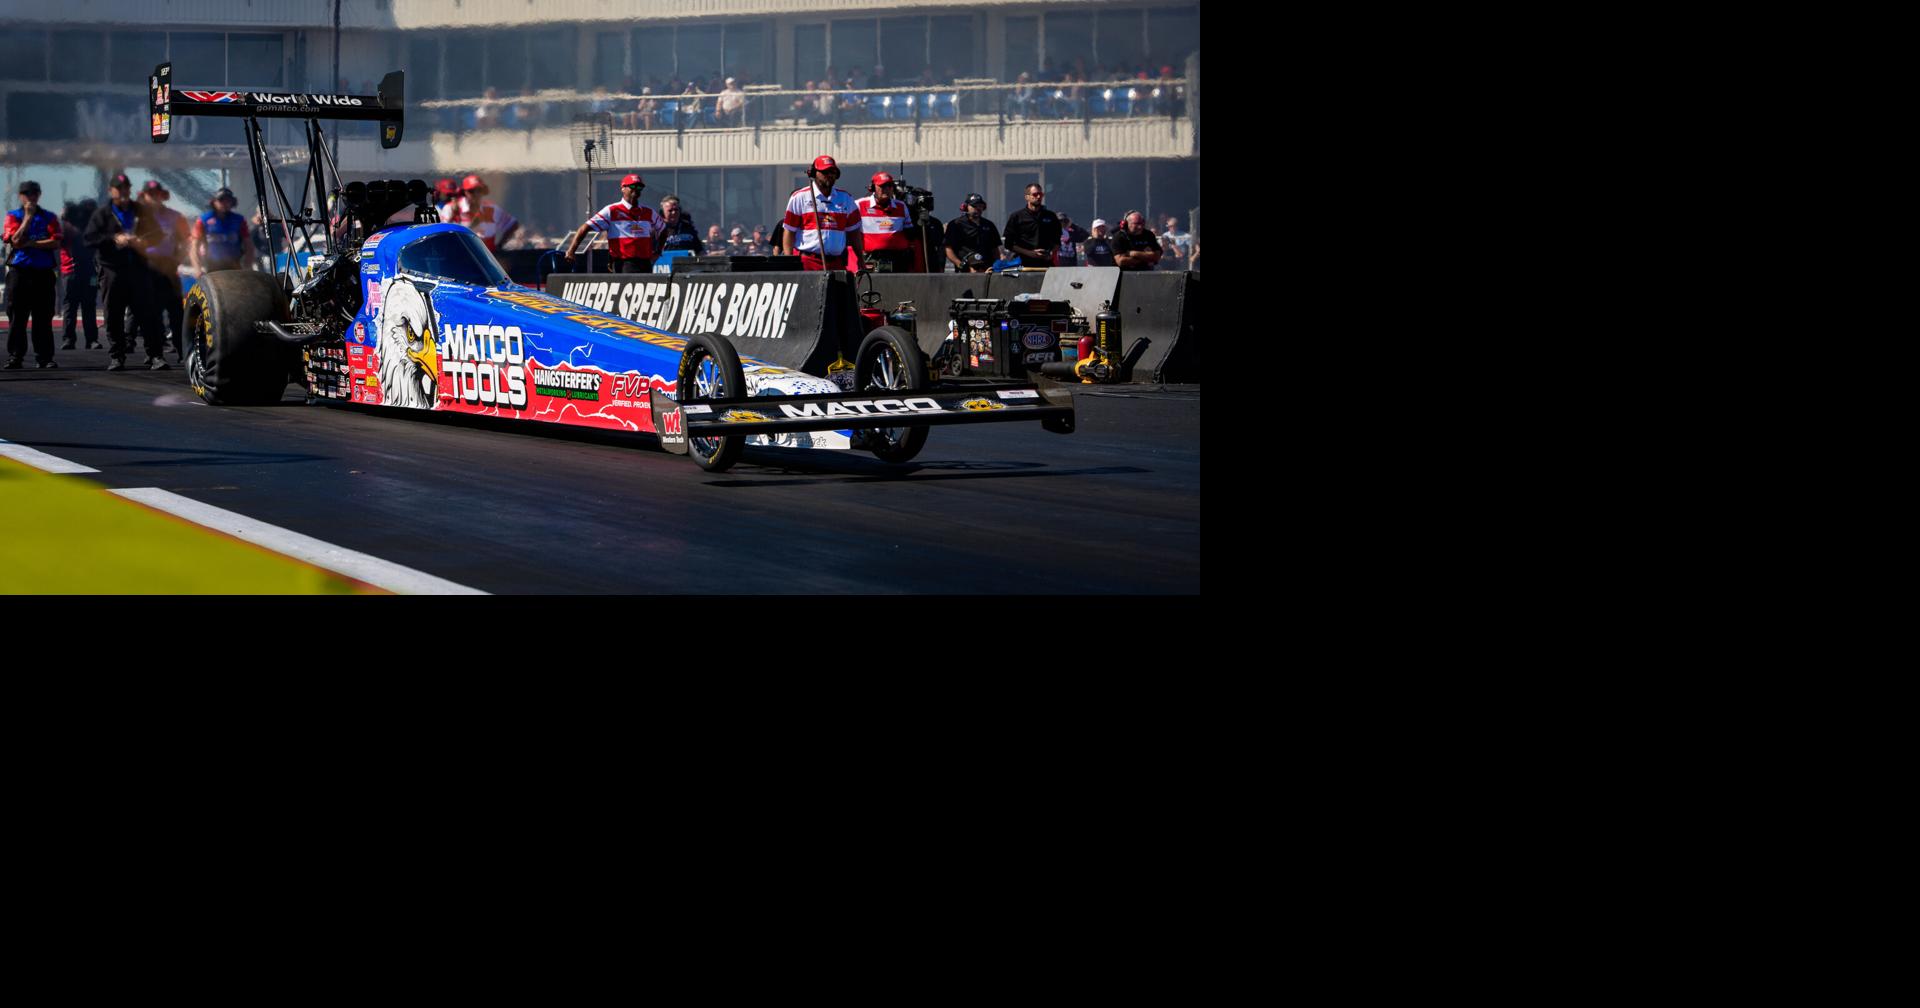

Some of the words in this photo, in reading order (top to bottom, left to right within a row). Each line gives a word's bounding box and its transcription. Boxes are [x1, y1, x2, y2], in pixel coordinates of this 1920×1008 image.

[256, 104, 320, 113] gomatco.com
[312, 94, 363, 106] Wide
[617, 282, 680, 331] SPEED
[677, 282, 727, 335] WAS
[721, 282, 799, 339] BORN!
[442, 323, 525, 365] MATCO
[442, 361, 527, 406] TOOLS
[534, 368, 601, 391] HANGSTERFER'S
[610, 374, 651, 397] FVP
[779, 397, 943, 418] MATCO
